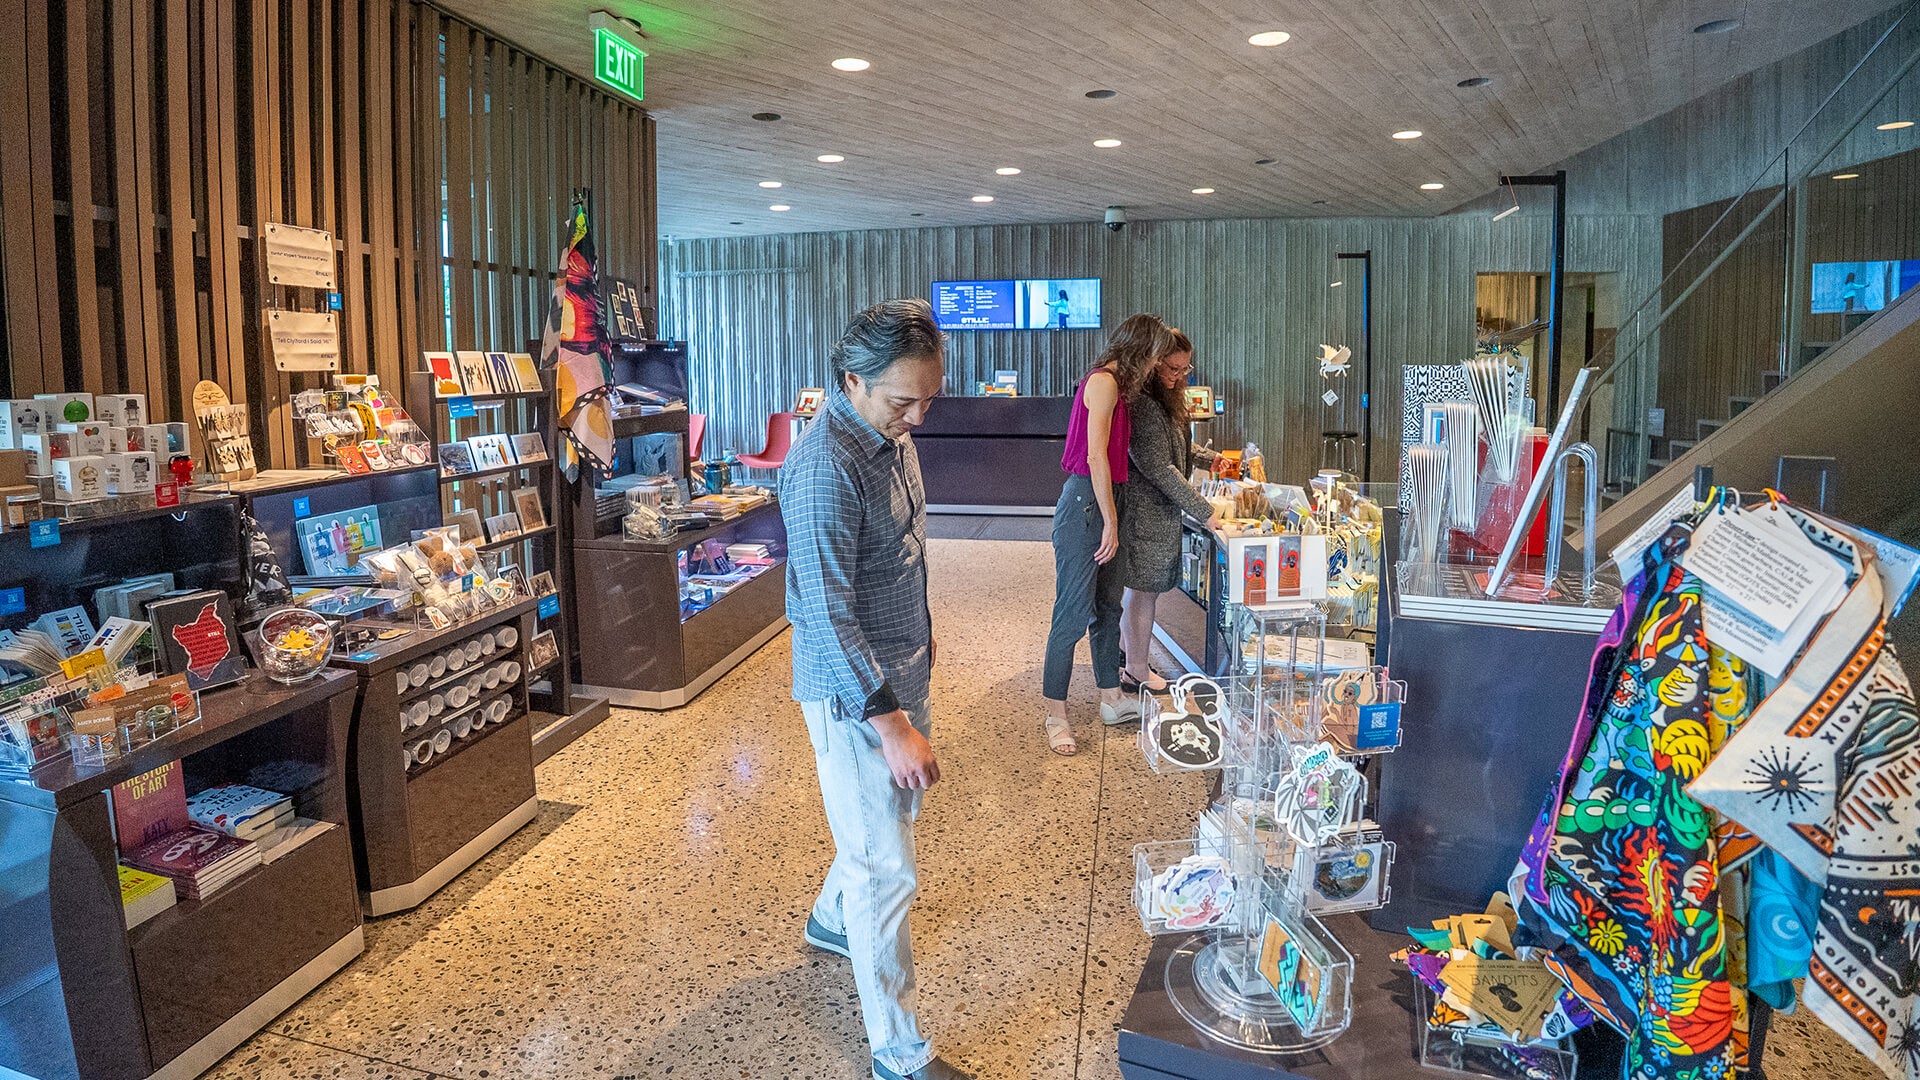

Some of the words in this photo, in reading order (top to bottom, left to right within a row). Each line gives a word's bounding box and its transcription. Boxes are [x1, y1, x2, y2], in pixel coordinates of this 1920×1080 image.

[605, 38, 637, 89] EXIT
[72, 612, 91, 642] STILL
[102, 625, 123, 650] TILL
[132, 782, 147, 800] OF
[148, 772, 169, 794] ART
[200, 789, 227, 804] GET
[211, 793, 236, 805] THE
[206, 788, 261, 816] PICTURE
[1471, 974, 1539, 987] BANDITS
